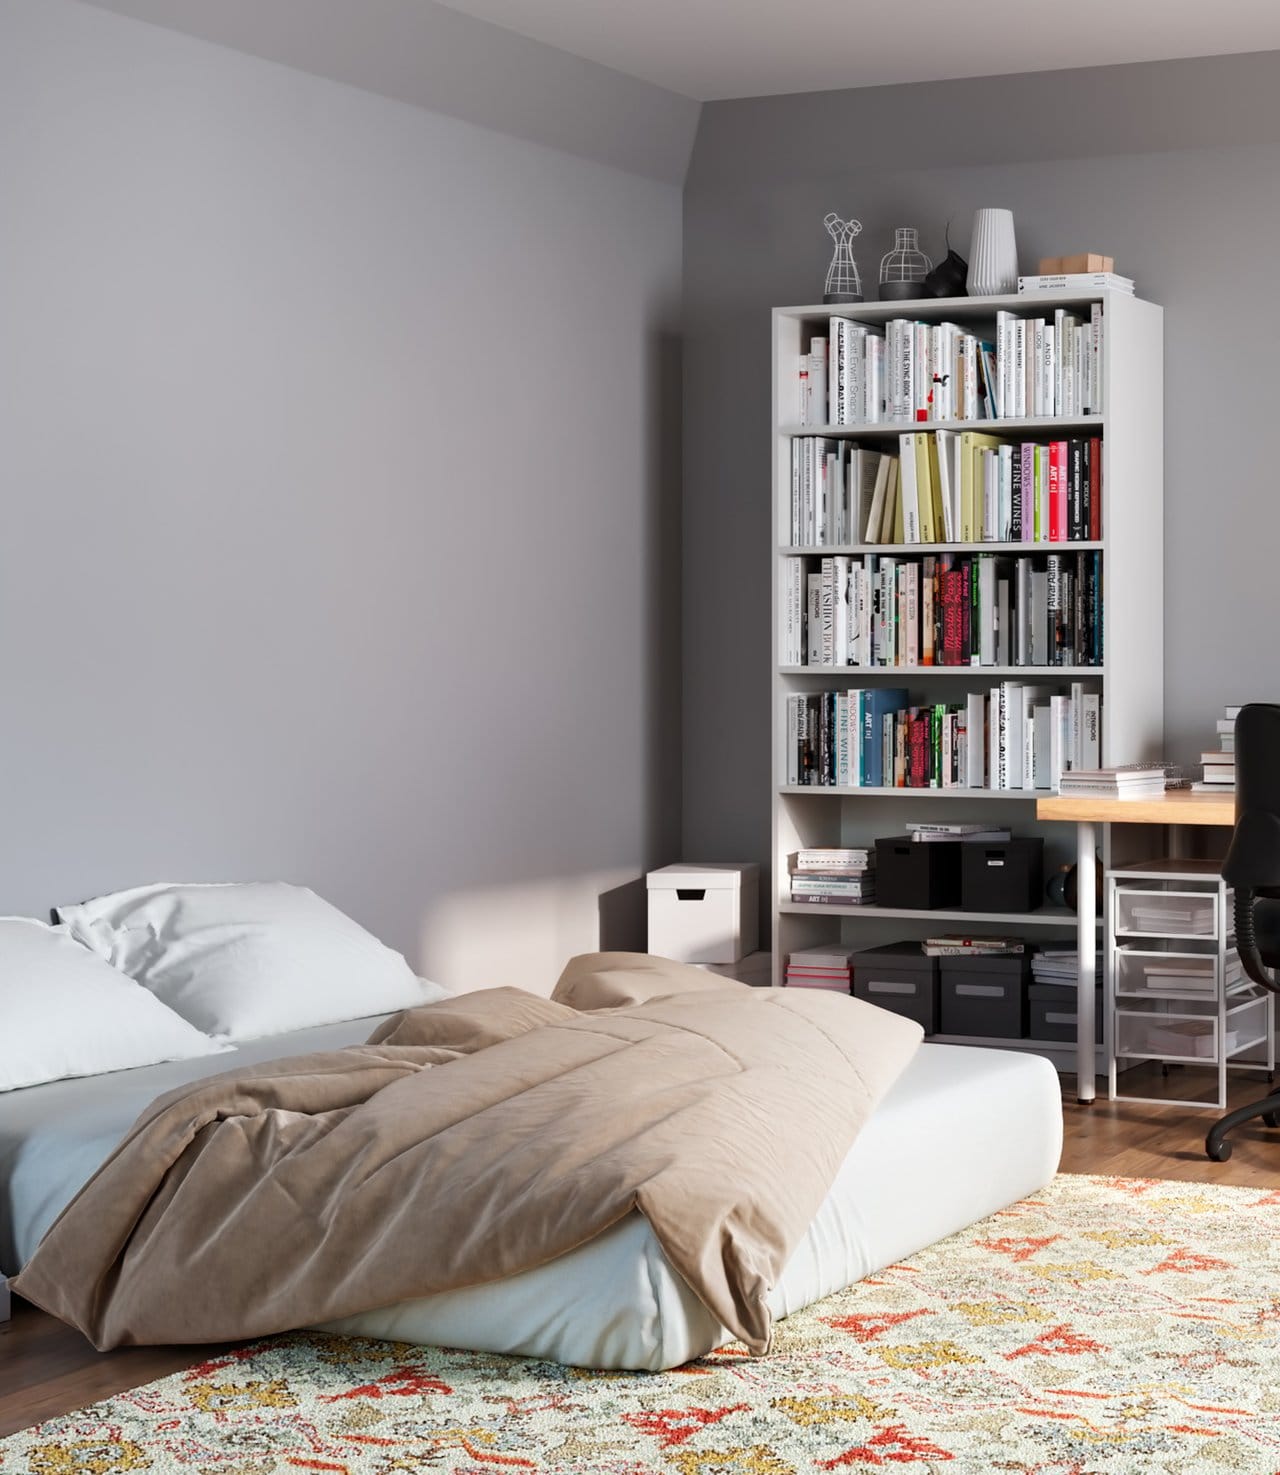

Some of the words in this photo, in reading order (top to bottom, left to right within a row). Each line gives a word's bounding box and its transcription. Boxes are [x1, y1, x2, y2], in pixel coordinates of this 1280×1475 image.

[1013, 463, 1021, 489] FINE
[1023, 447, 1031, 487] WINDOWS
[1013, 494, 1021, 531] WINES
[823, 559, 832, 583] THE
[823, 585, 832, 631] FASHION
[840, 709, 848, 733] FINE
[840, 738, 848, 775] WINES
